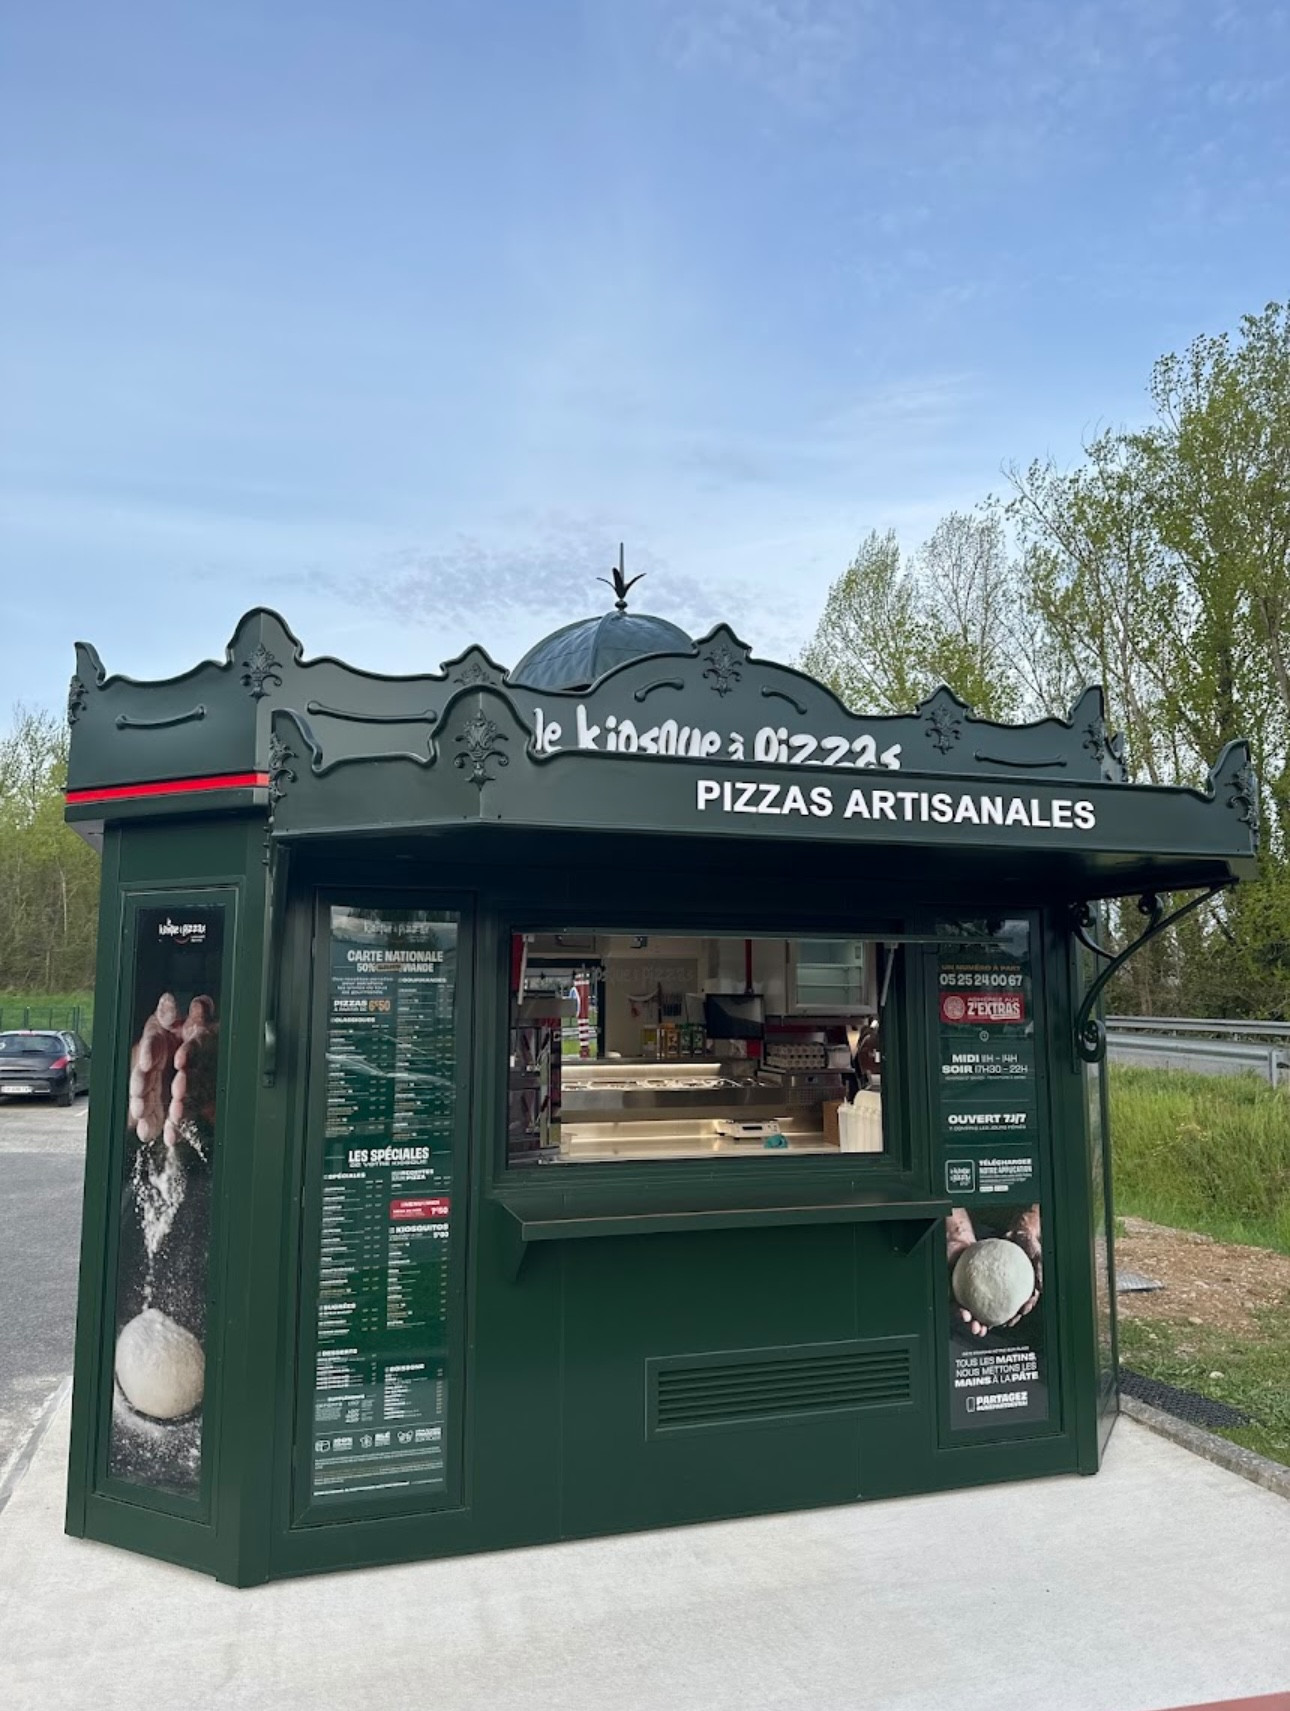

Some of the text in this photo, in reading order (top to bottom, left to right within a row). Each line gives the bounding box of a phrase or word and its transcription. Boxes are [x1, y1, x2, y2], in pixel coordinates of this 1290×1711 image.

[534, 707, 563, 752] le
[696, 779, 1096, 829] PIZZAS ARTISANALES
[347, 950, 444, 962] CARTE NATIONALE
[967, 1001, 1021, 1016] Z'EXTRAS
[952, 1054, 980, 1063] MIDI
[942, 1065, 973, 1074] SOIR
[974, 1065, 1001, 1074] 17H30
[1010, 1064, 1028, 1073] 22H
[948, 1114, 1001, 1125] OUVERT
[349, 1146, 430, 1162] LES SPÉCIALES
[979, 1158, 1033, 1167] TÉLÉCHARGEZ
[955, 1352, 1036, 1368] TOUS LES MATINS
[956, 1361, 1037, 1378] NOUS METTONS LES
[954, 1376, 992, 1388] MAINS
[1000, 1374, 1011, 1383] LA
[1011, 1370, 1039, 1382] PÂTE
[976, 1391, 1028, 1405] PARTAGEZ
